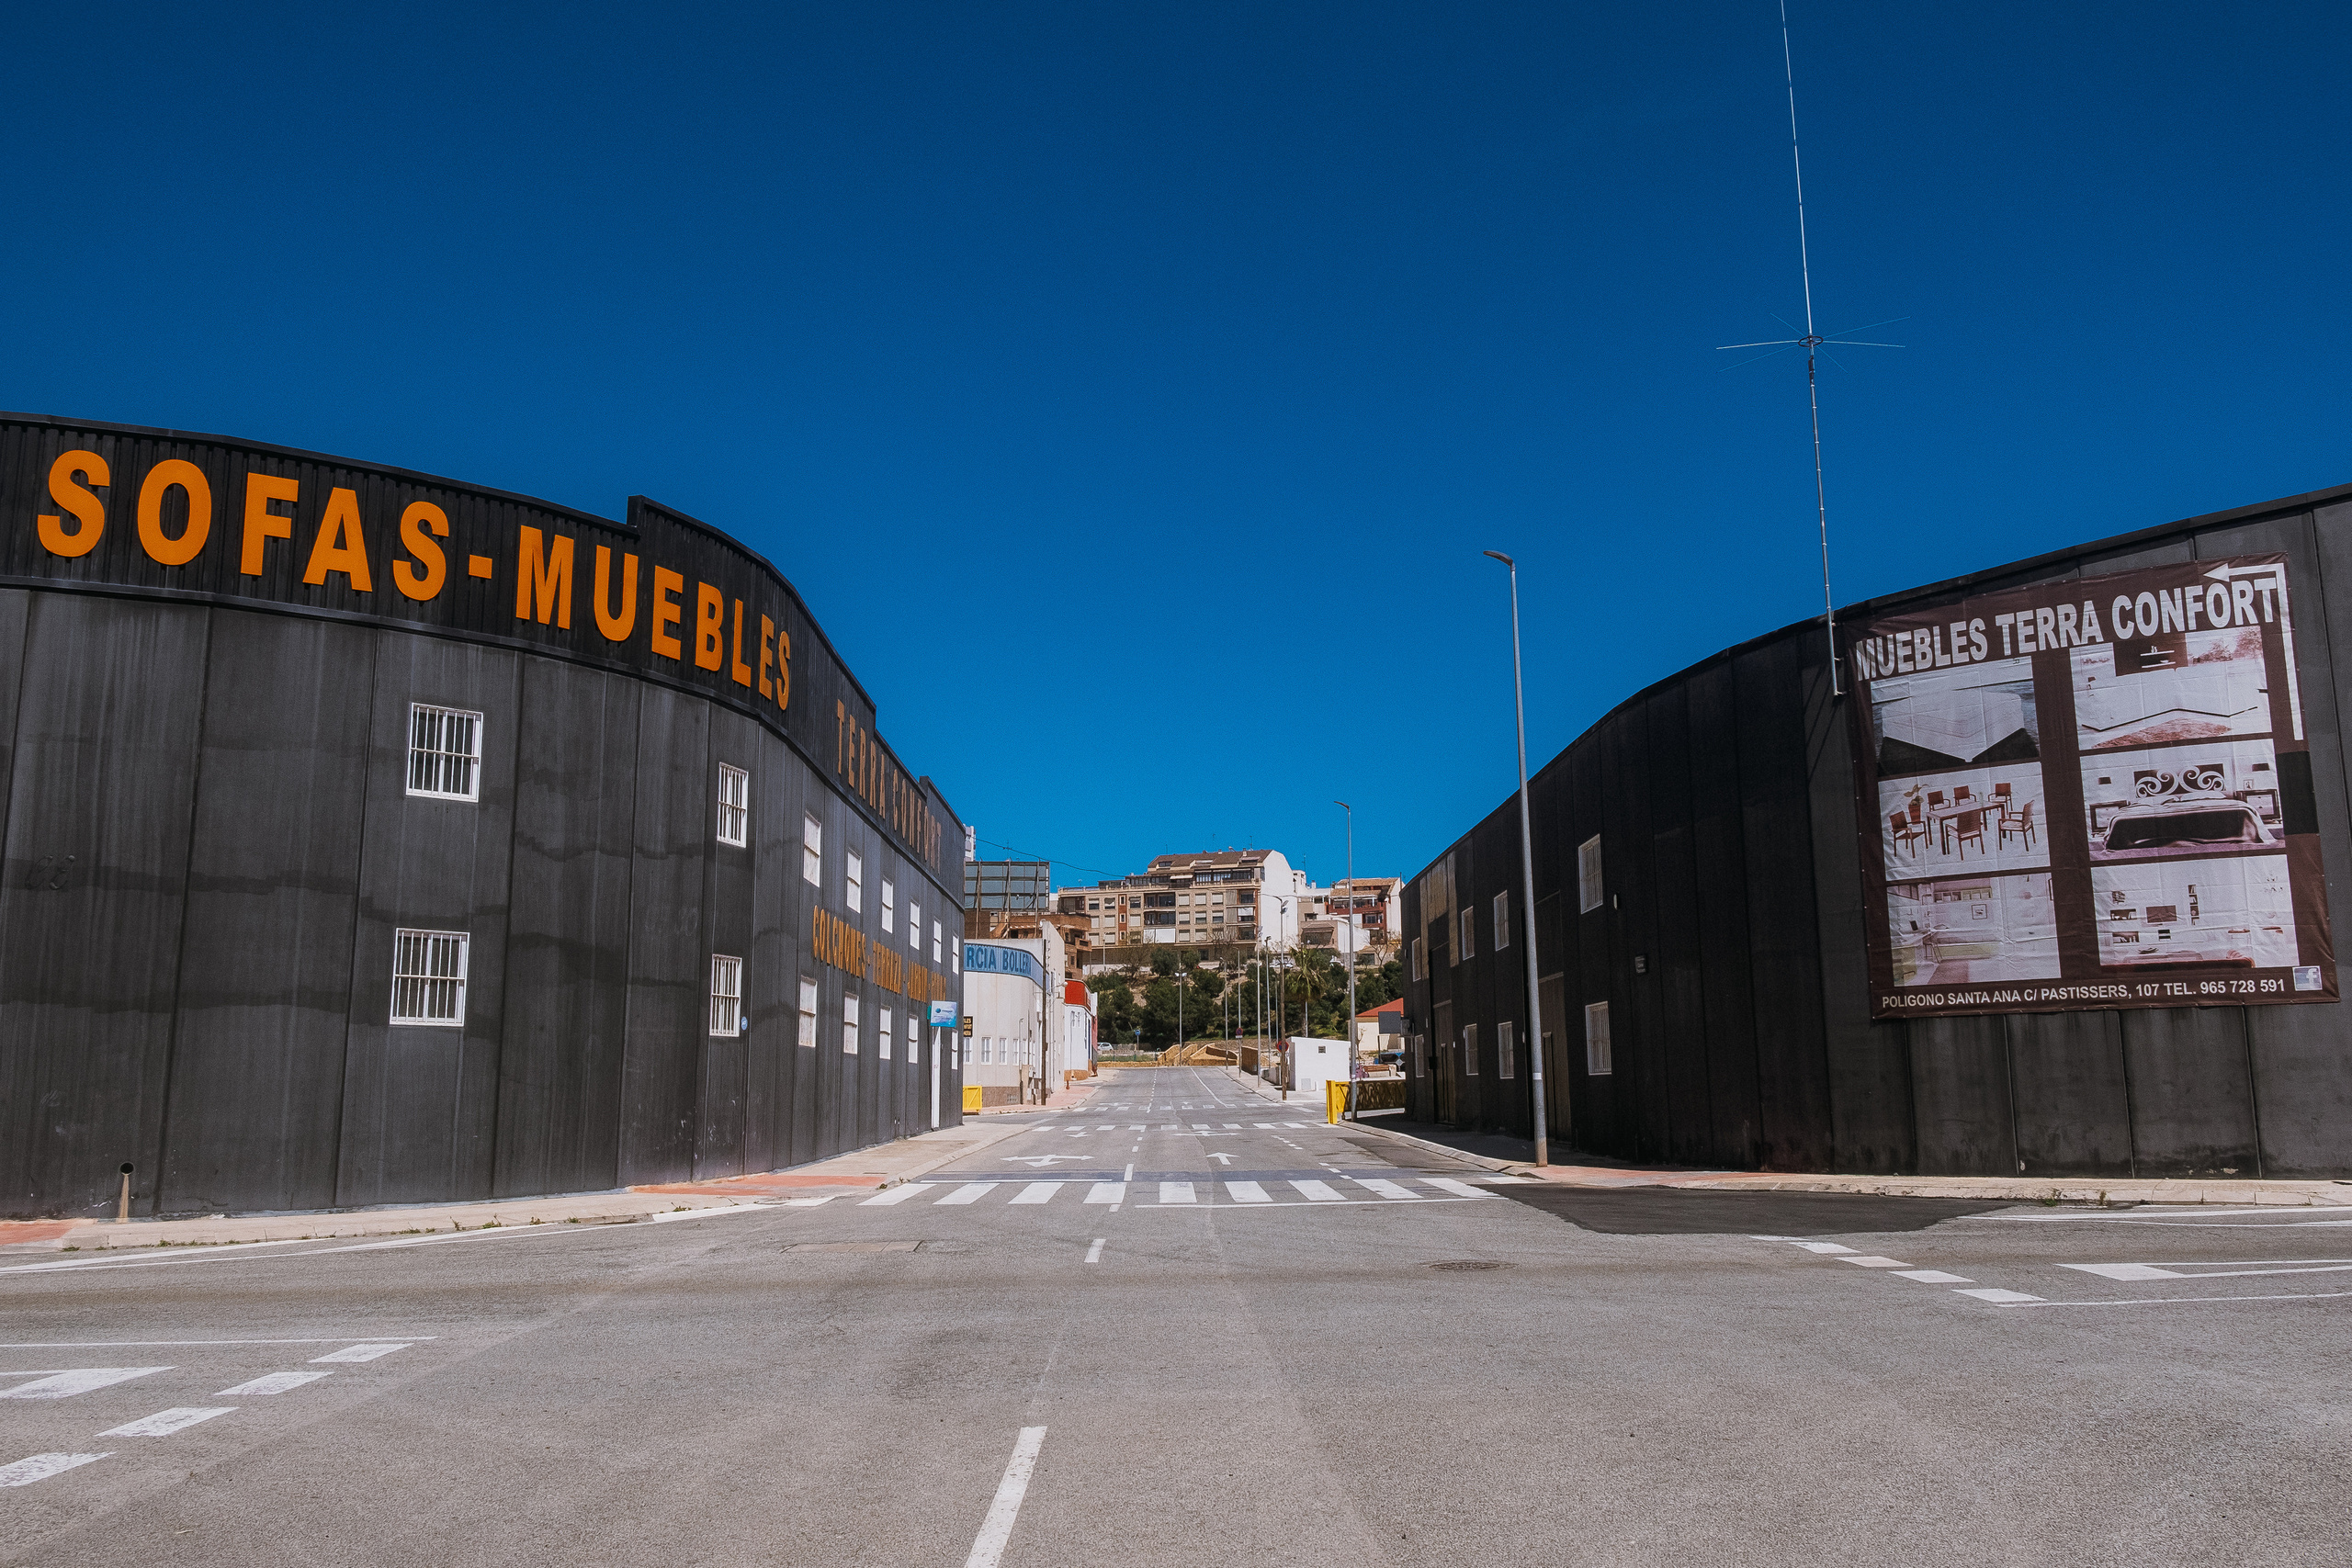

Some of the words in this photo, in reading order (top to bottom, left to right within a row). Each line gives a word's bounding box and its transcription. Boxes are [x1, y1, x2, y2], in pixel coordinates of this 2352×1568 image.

[1856, 617, 1988, 681] MUEBLES
[1995, 600, 2105, 656] TERRA
[2112, 577, 2277, 640] CONFORT
[837, 699, 886, 819] TERRA
[892, 769, 942, 875] CONFORT
[812, 905, 866, 979] COLCHONES
[1883, 993, 1945, 1009] POLIGONO
[1947, 991, 1991, 1005] SANTA
[1992, 989, 2022, 1003] ANA
[2023, 988, 2038, 1001] C/
[2041, 985, 2132, 1000] PASTISSERS,
[2135, 983, 2160, 997] 107
[2163, 982, 2197, 996] TEL.
[2199, 981, 2227, 994] 965
[2229, 979, 2256, 993] 728
[2259, 978, 2286, 992] 591
